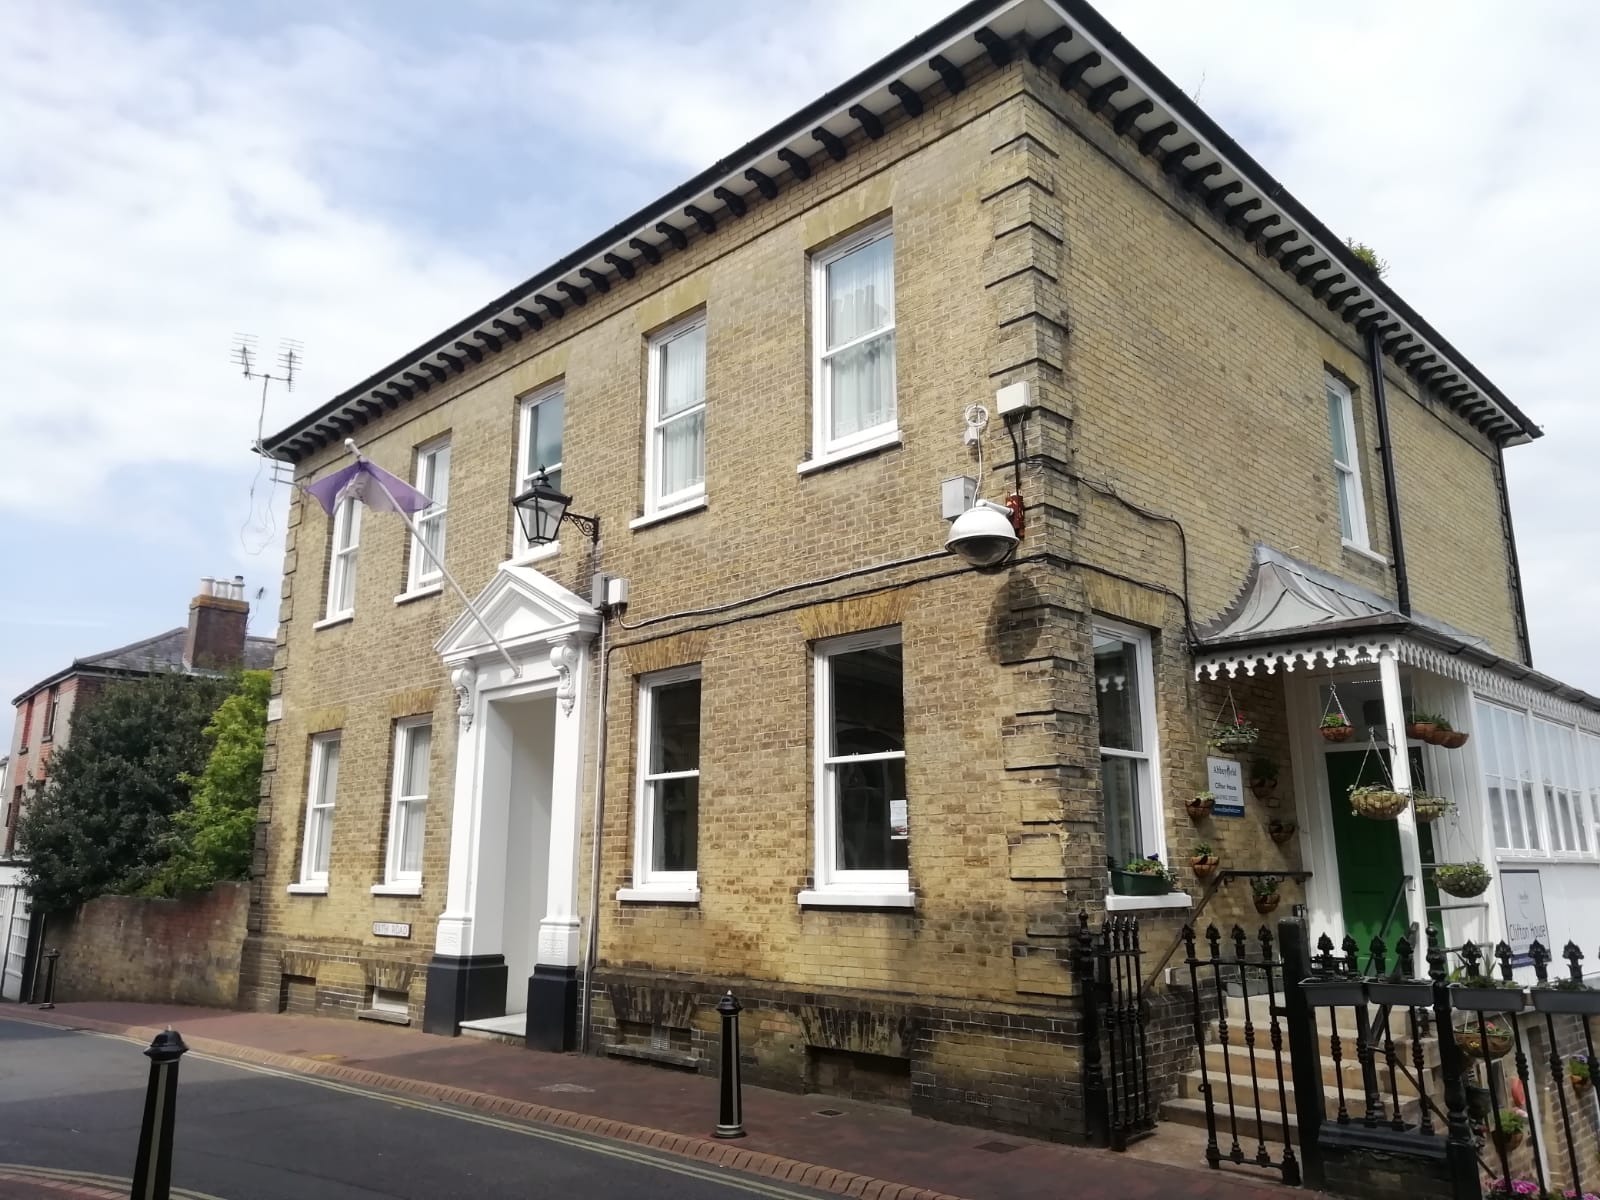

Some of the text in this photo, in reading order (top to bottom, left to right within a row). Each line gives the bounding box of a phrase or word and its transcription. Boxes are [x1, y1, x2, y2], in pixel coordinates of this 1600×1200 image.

[391, 925, 408, 935] ROAD
[1509, 922, 1546, 942] Clifton House
